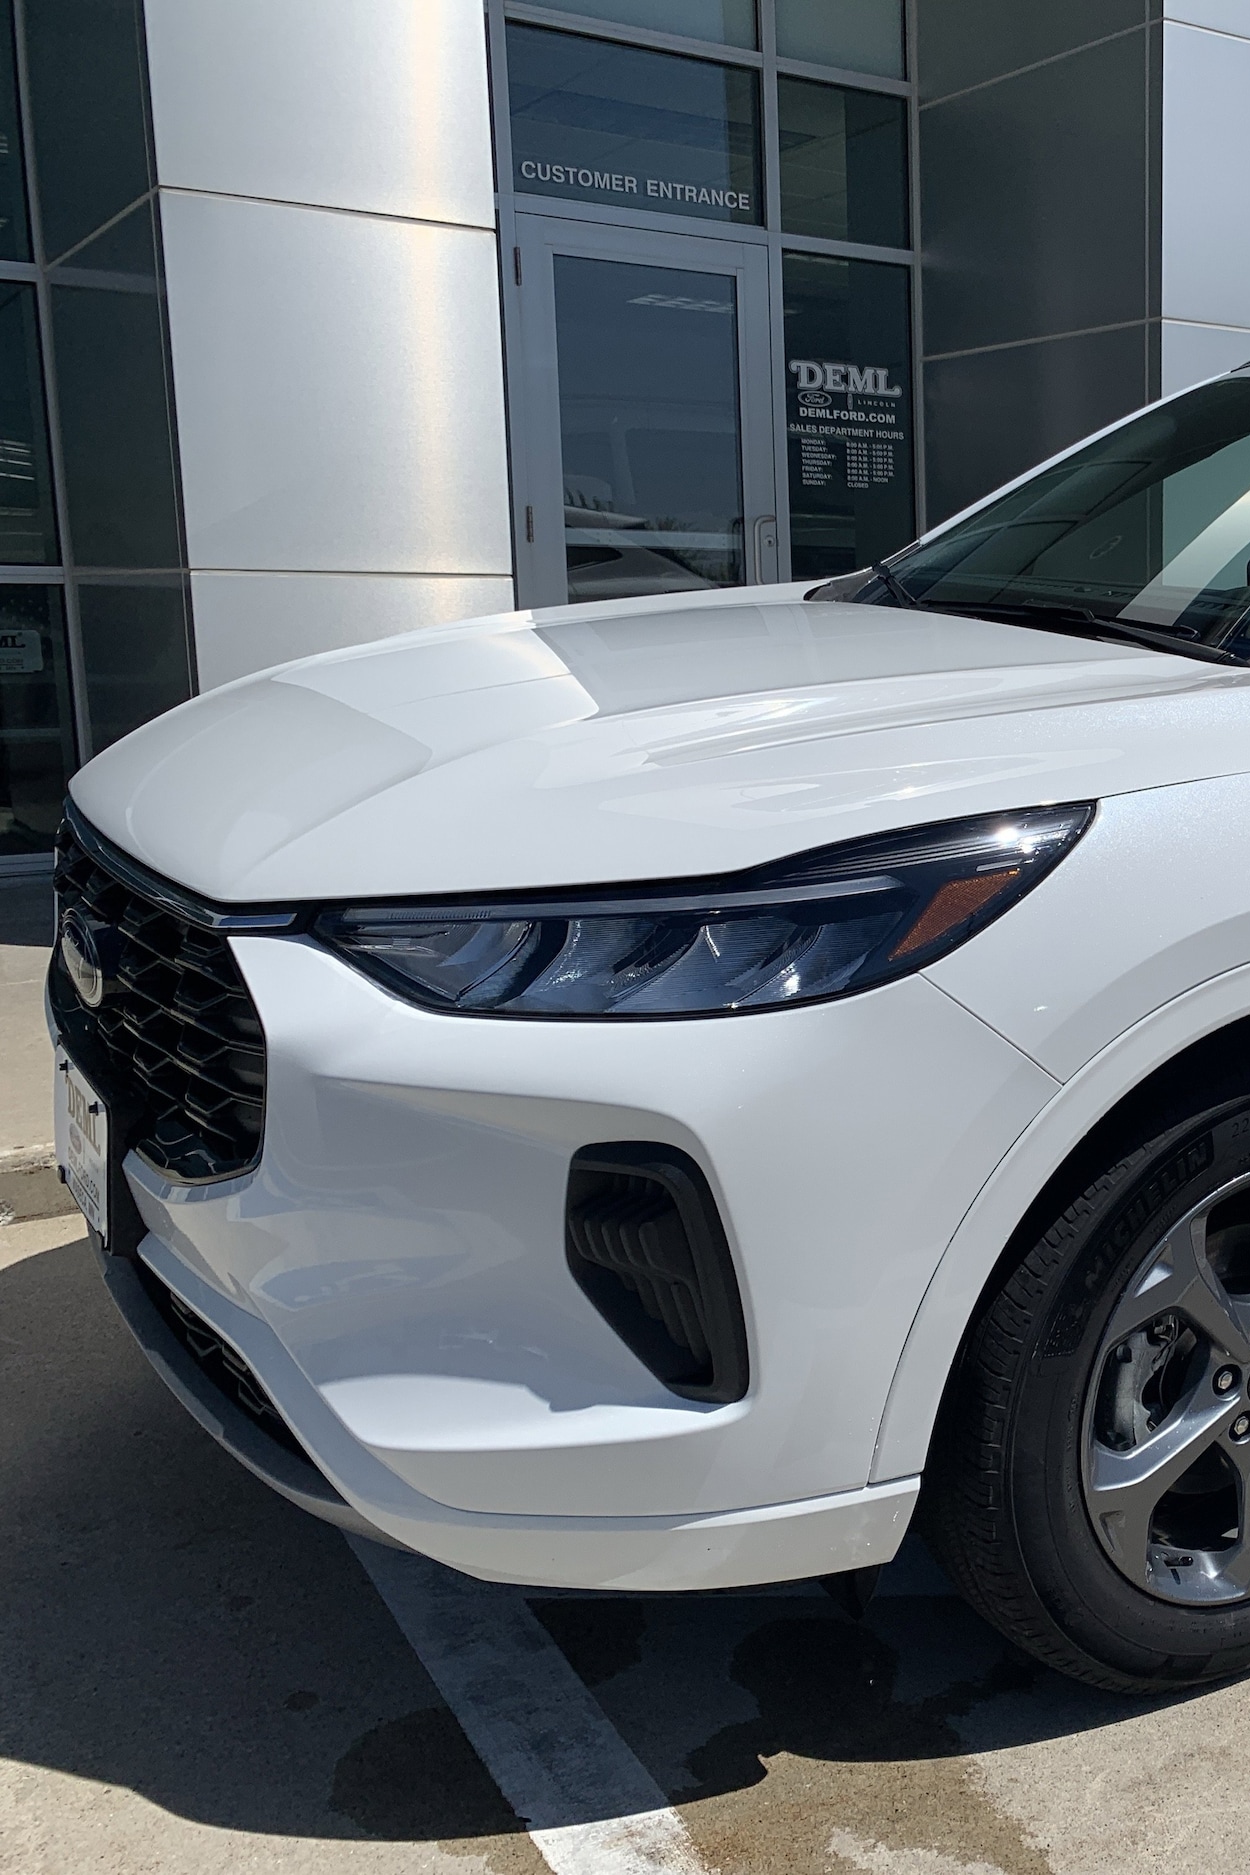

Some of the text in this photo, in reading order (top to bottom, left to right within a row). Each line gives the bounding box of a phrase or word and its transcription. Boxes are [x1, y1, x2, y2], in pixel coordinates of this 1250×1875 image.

[521, 160, 750, 210] CUSTOMER ENTRANCE
[789, 360, 902, 398] DEML
[857, 399, 896, 408] LINCOLN
[799, 406, 896, 424] DEMLFORD.COM
[789, 423, 905, 440] SALES DEPARTMENT HOURS
